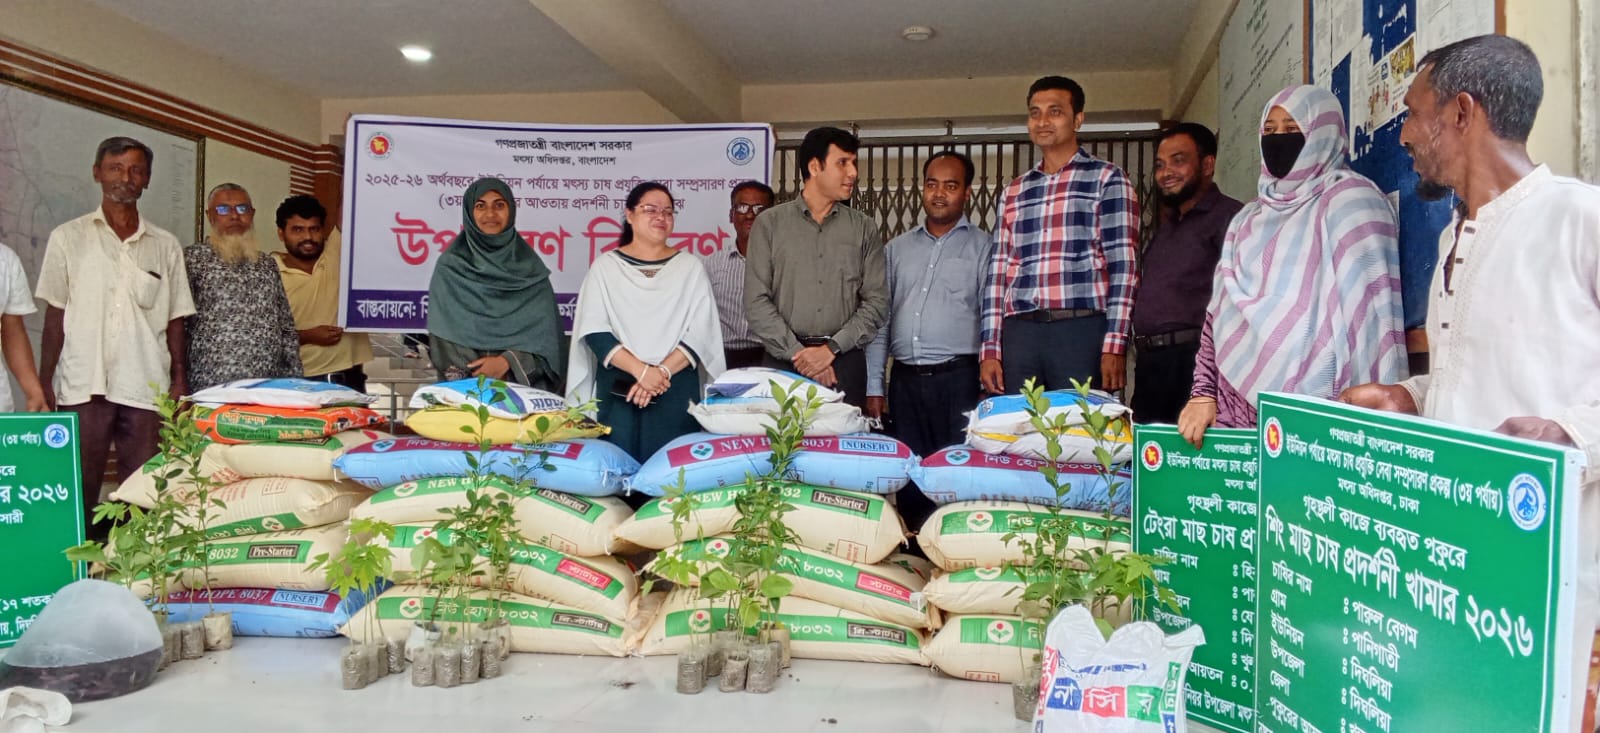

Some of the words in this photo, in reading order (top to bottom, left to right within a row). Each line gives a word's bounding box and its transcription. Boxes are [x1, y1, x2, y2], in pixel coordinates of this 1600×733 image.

[495, 137, 547, 151] গণপ্রজাতন্ত্রী
[551, 140, 597, 151] বাংলাদেশ
[599, 140, 633, 151] সরকার
[512, 154, 533, 165] মৎস্য
[578, 155, 616, 166] বাংলাদেশ
[365, 173, 423, 187] ২০২৫-২৬
[562, 177, 589, 190] মৎস্য
[593, 178, 611, 191] চাষ
[676, 177, 725, 192] সম্প্রসারণ
[525, 197, 569, 209] আওতায়
[571, 193, 609, 210] প্রদর্শনী
[720, 439, 755, 452] NEW
[801, 437, 833, 448] 8037
[844, 439, 895, 452] NURSERY
[1329, 427, 1365, 447] গণপ্রজাতন্ত্রী
[1366, 435, 1403, 456] বাংলাদেশ
[1404, 444, 1434, 463] সরকার
[983, 453, 1012, 465] নিউ
[1229, 460, 1241, 473] চাষ
[427, 477, 458, 489] NEW
[1327, 447, 1342, 468] মৎস্য
[1343, 451, 1355, 472] চাষ
[1355, 451, 1375, 480] প্রযুক্তি
[1376, 461, 1392, 482] সেবা
[1393, 464, 1428, 492] সম্প্রসারণ
[1429, 474, 1452, 499] প্রকল্প
[18, 483, 69, 505] ২০২৬
[1224, 479, 1244, 490] মৎস্য
[818, 492, 864, 511] Pre-Starter
[1337, 477, 1356, 495] মৎস্য
[1398, 495, 1420, 515] ঢাকা
[1226, 500, 1257, 516] কাজে
[1143, 506, 1178, 540] টেংরা
[1180, 519, 1208, 548] মাছ
[1210, 523, 1237, 550] চাষ
[1338, 506, 1371, 535] কাজে
[1423, 536, 1468, 571] পুকুরে
[208, 547, 240, 560] 8032
[1180, 553, 1199, 569] নাম
[803, 560, 845, 583] ৮০৩২
[1265, 504, 1285, 552] শিং
[1287, 522, 1313, 566] মাছ
[1314, 532, 1341, 573] চাষ
[1343, 546, 1400, 599] প্রদর্শনী
[1404, 567, 1460, 626] খামার
[1465, 594, 1534, 658] ২০২৬
[239, 589, 270, 601] 8037
[280, 592, 320, 605] NURSERY
[1271, 560, 1294, 586] চাষির
[1295, 571, 1312, 596] নাম
[1352, 600, 1384, 632] পারুল
[1386, 618, 1418, 649] বেগম
[1152, 606, 1192, 630] উপজেলা
[790, 623, 834, 636] ৮০৩২
[1270, 588, 1287, 611] গ্রাম
[1351, 631, 1400, 673] পানিগাতী
[1270, 609, 1304, 650] ইউনিয়ন
[1350, 655, 1393, 702] দিঘলিয়া
[1270, 670, 1291, 696] জেলা
[1270, 636, 1306, 679] উপজেলা
[1349, 686, 1392, 733] দিঘলিয়া
[1203, 688, 1235, 719] উপজেলা
[1269, 696, 1299, 730] পুকুরের
